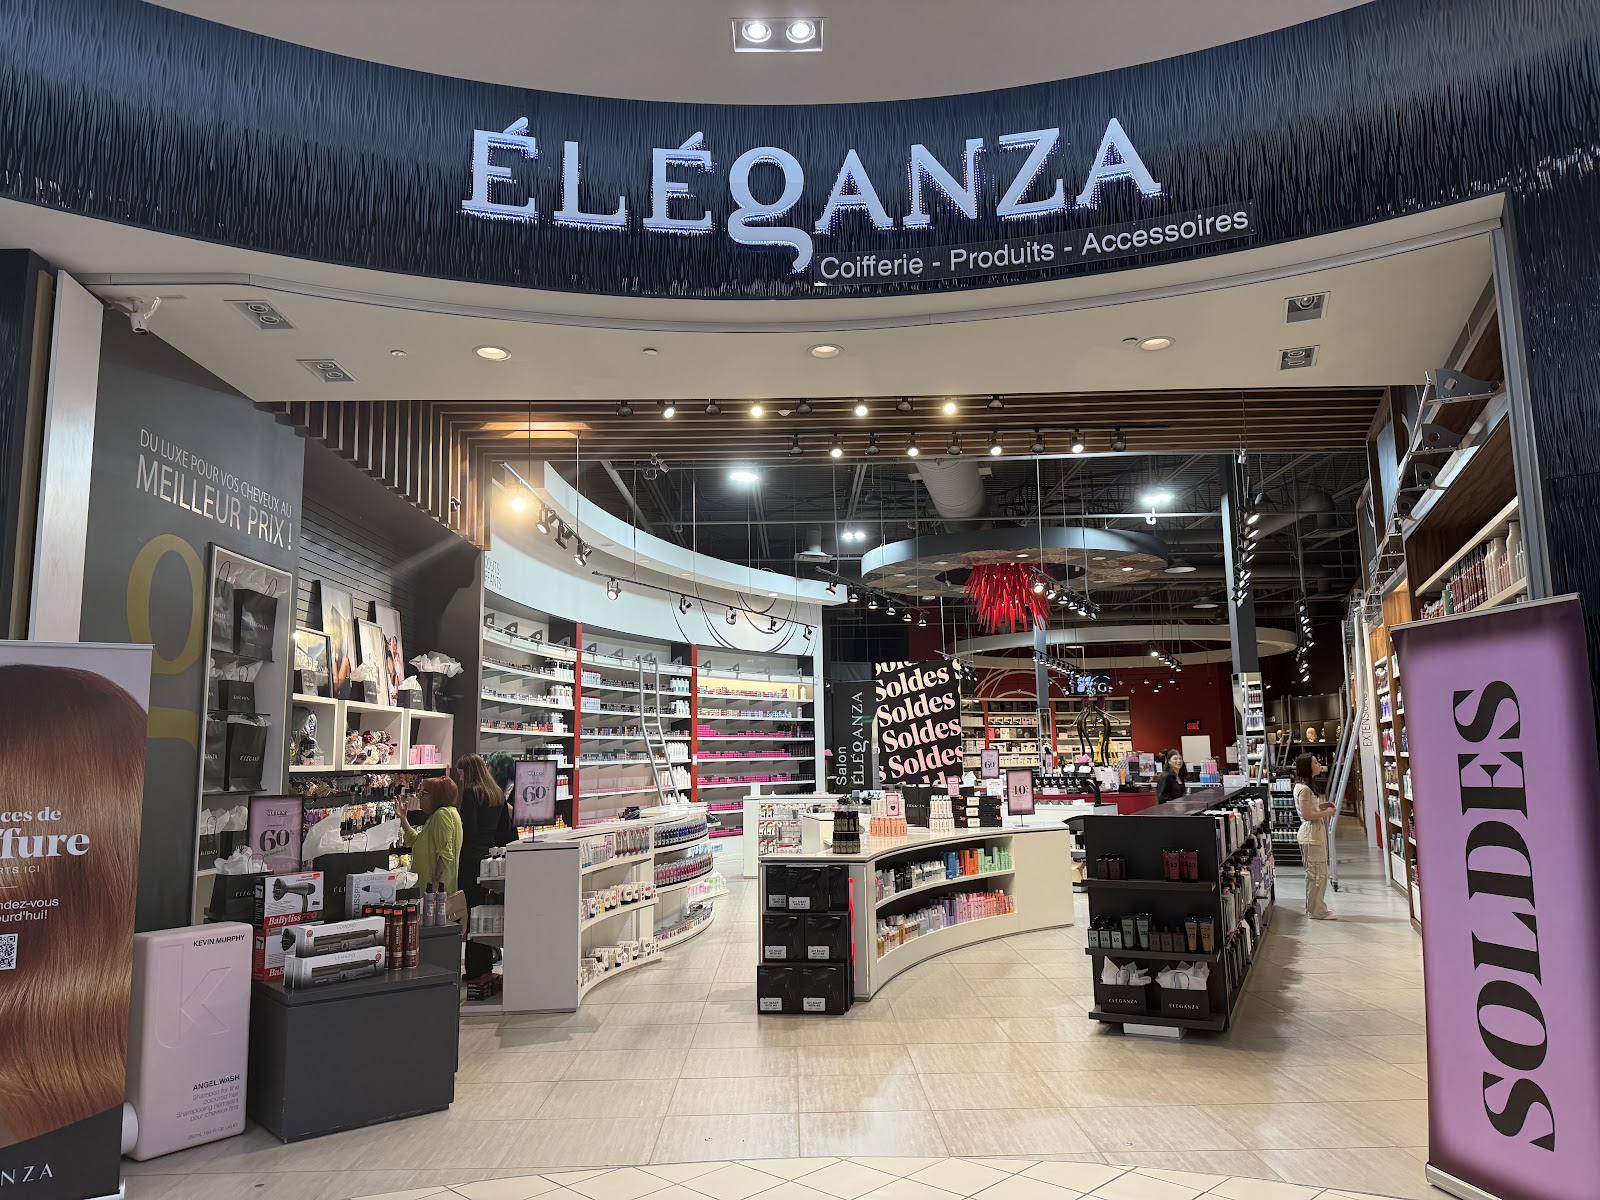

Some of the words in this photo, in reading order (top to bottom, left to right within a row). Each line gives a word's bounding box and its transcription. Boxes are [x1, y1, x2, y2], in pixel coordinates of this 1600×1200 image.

[820, 253, 924, 280] Coifferie
[950, 241, 1055, 271] Produits
[1081, 209, 1250, 256] Accessoires
[140, 429, 158, 452] DU
[161, 439, 189, 468] LUXE
[190, 455, 219, 484] POUR
[220, 469, 239, 493] VOS
[241, 481, 280, 512] CHEVEUX
[281, 501, 292, 518] AU
[136, 454, 241, 531] MEILLEUR
[247, 505, 284, 548] PRIX
[876, 667, 950, 702] Soldes
[877, 693, 956, 728] Soldes
[882, 719, 961, 753] Soldes
[836, 746, 847, 786] Salon
[888, 745, 963, 778] Soldes
[0, 811, 33, 822] ces
[37, 806, 61, 821] de
[24, 865, 40, 873] ICI
[1453, 680, 1556, 1153] SOLDES
[192, 1089, 220, 1101] Shampoo
[0, 1163, 53, 1186] NZA
